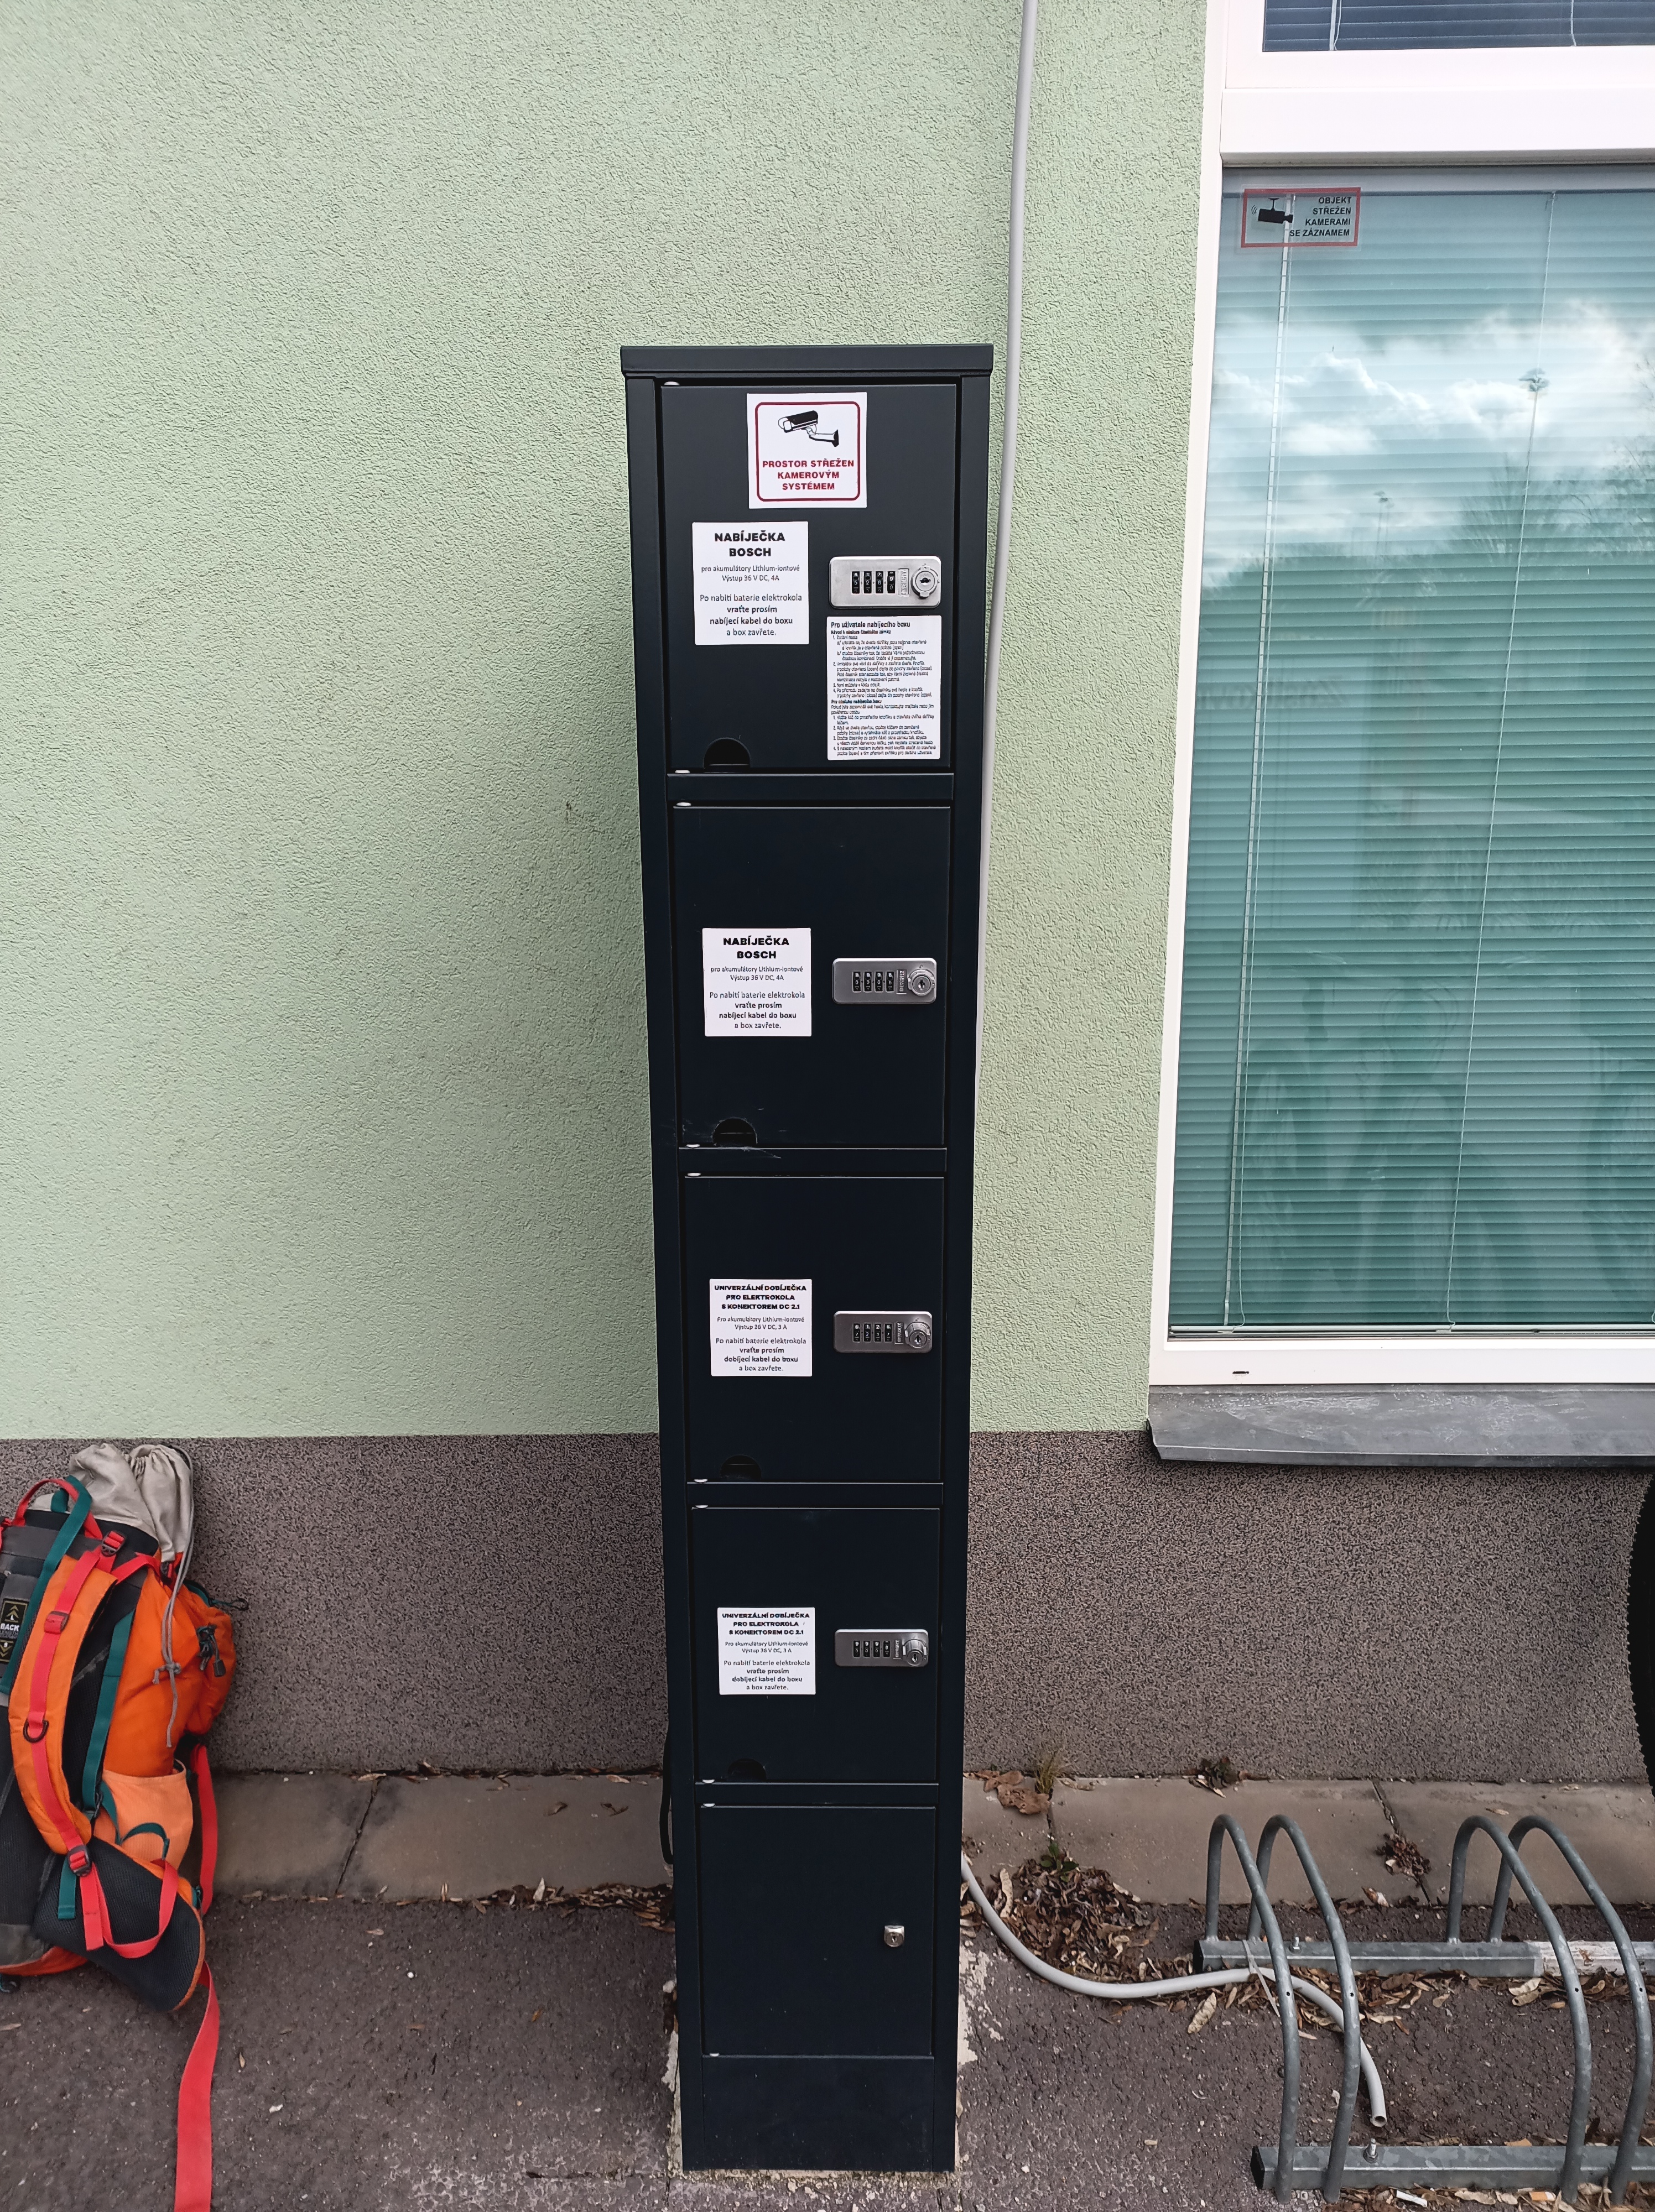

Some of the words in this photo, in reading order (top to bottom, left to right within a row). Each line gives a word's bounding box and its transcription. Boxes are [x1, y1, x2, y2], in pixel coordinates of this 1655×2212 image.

[1313, 206, 1351, 215] STŘEŽEN
[1303, 227, 1350, 237] ZÁZNAMEM
[762, 460, 808, 468] PROSTOR
[810, 457, 854, 468] STŘEŽEN
[777, 469, 840, 479] KAMEROVÝM
[782, 481, 835, 491] SYSTÉMEM
[714, 529, 785, 542] NABÍJEČKA
[728, 547, 772, 557] BOSCH
[712, 565, 751, 573] akumulátory
[721, 575, 743, 583] Výstup
[711, 593, 732, 602] nabití
[733, 593, 760, 602] baterie
[762, 593, 802, 602] elektrokola
[726, 604, 750, 613] vraťte
[751, 605, 778, 614] prosím
[710, 617, 740, 626] nabíjecí
[741, 616, 761, 625] kabel
[763, 616, 773, 624] do
[774, 616, 793, 624] boxu
[732, 628, 746, 636] box
[747, 628, 777, 636] zavřete.
[723, 935, 790, 946] NABÍJEČKA
[737, 951, 777, 959] BOSCH
[720, 990, 740, 999] nabití
[741, 990, 766, 999] baterie
[767, 990, 805, 999] elektrokola
[758, 1001, 782, 1010] prosím
[719, 1011, 747, 1020] nabíjecí
[761, 1347, 784, 1355] prosím
[724, 1355, 751, 1364] dobíjecí
